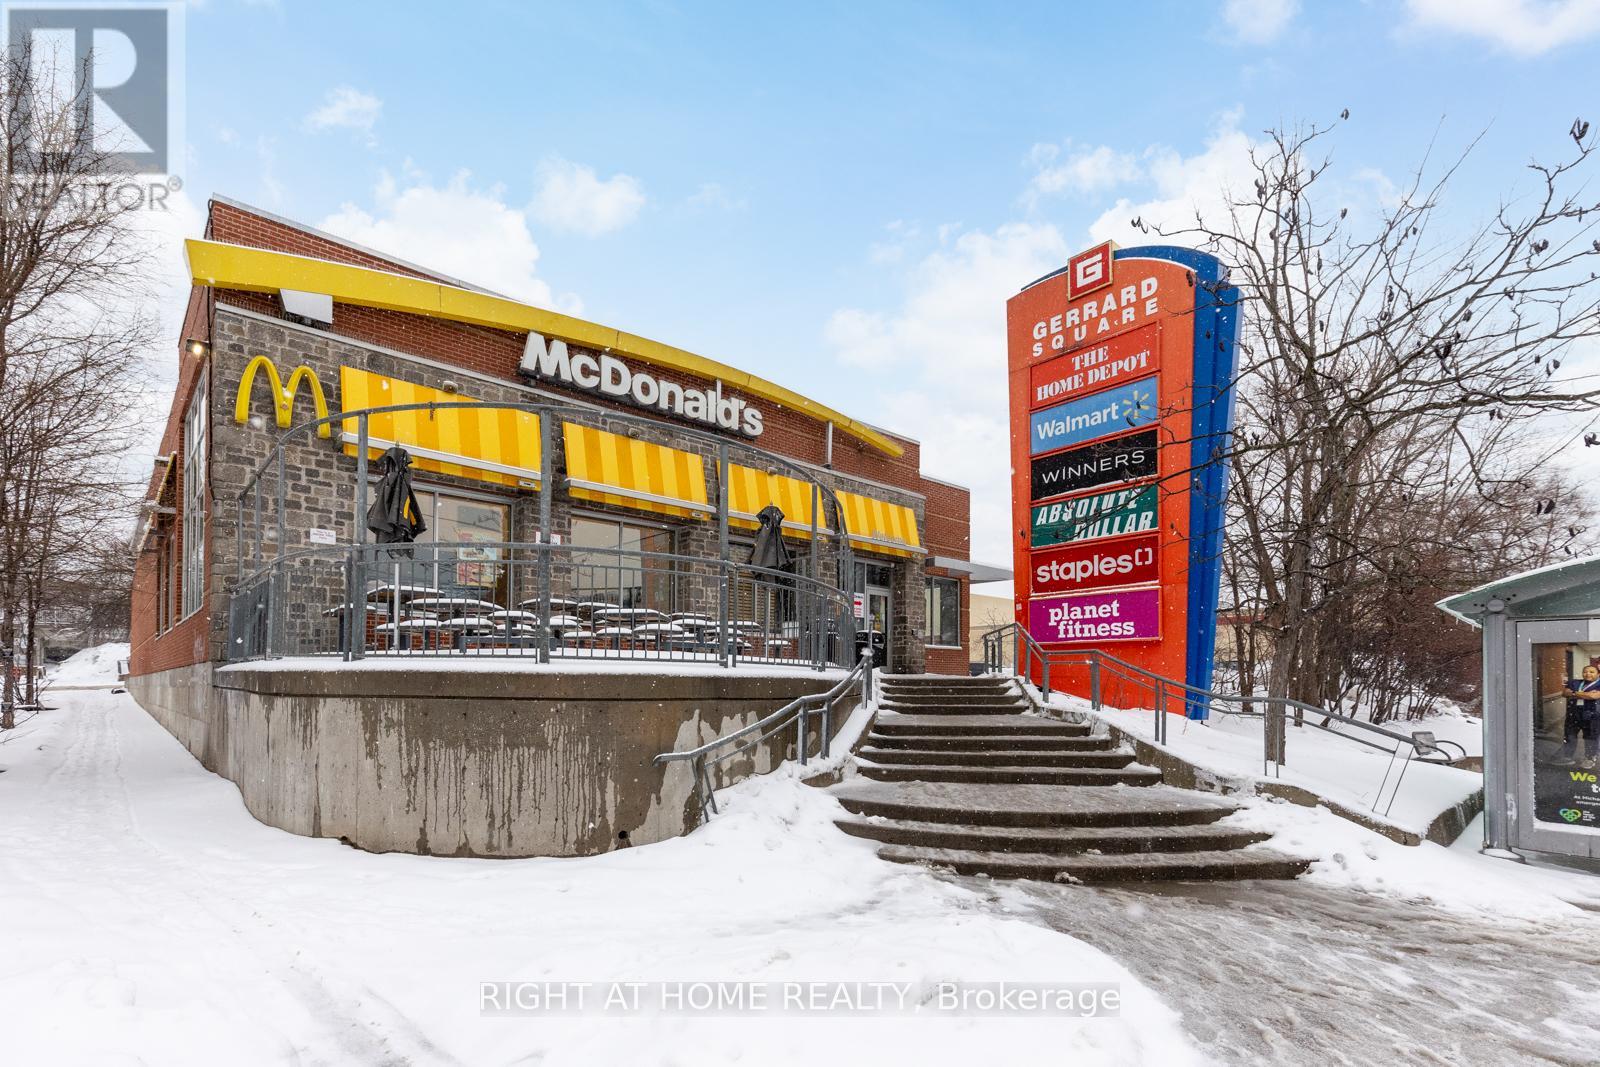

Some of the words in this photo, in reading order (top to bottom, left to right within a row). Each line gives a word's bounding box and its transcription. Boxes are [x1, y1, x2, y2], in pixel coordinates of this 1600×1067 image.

[1033, 277, 1158, 340] GERRARD
[1033, 298, 1158, 357] SQUARE
[1072, 346, 1109, 371] THE
[520, 331, 764, 437] McDonald's
[1037, 373, 1084, 401] HOME
[1087, 351, 1150, 385] DEPOT
[1037, 402, 1119, 440] Walmart
[1042, 450, 1145, 484] WINNERS
[1036, 554, 1133, 583] staples
[1049, 600, 1120, 626] planet
[1058, 620, 1135, 639] fitness
[1570, 771, 1597, 782] We
